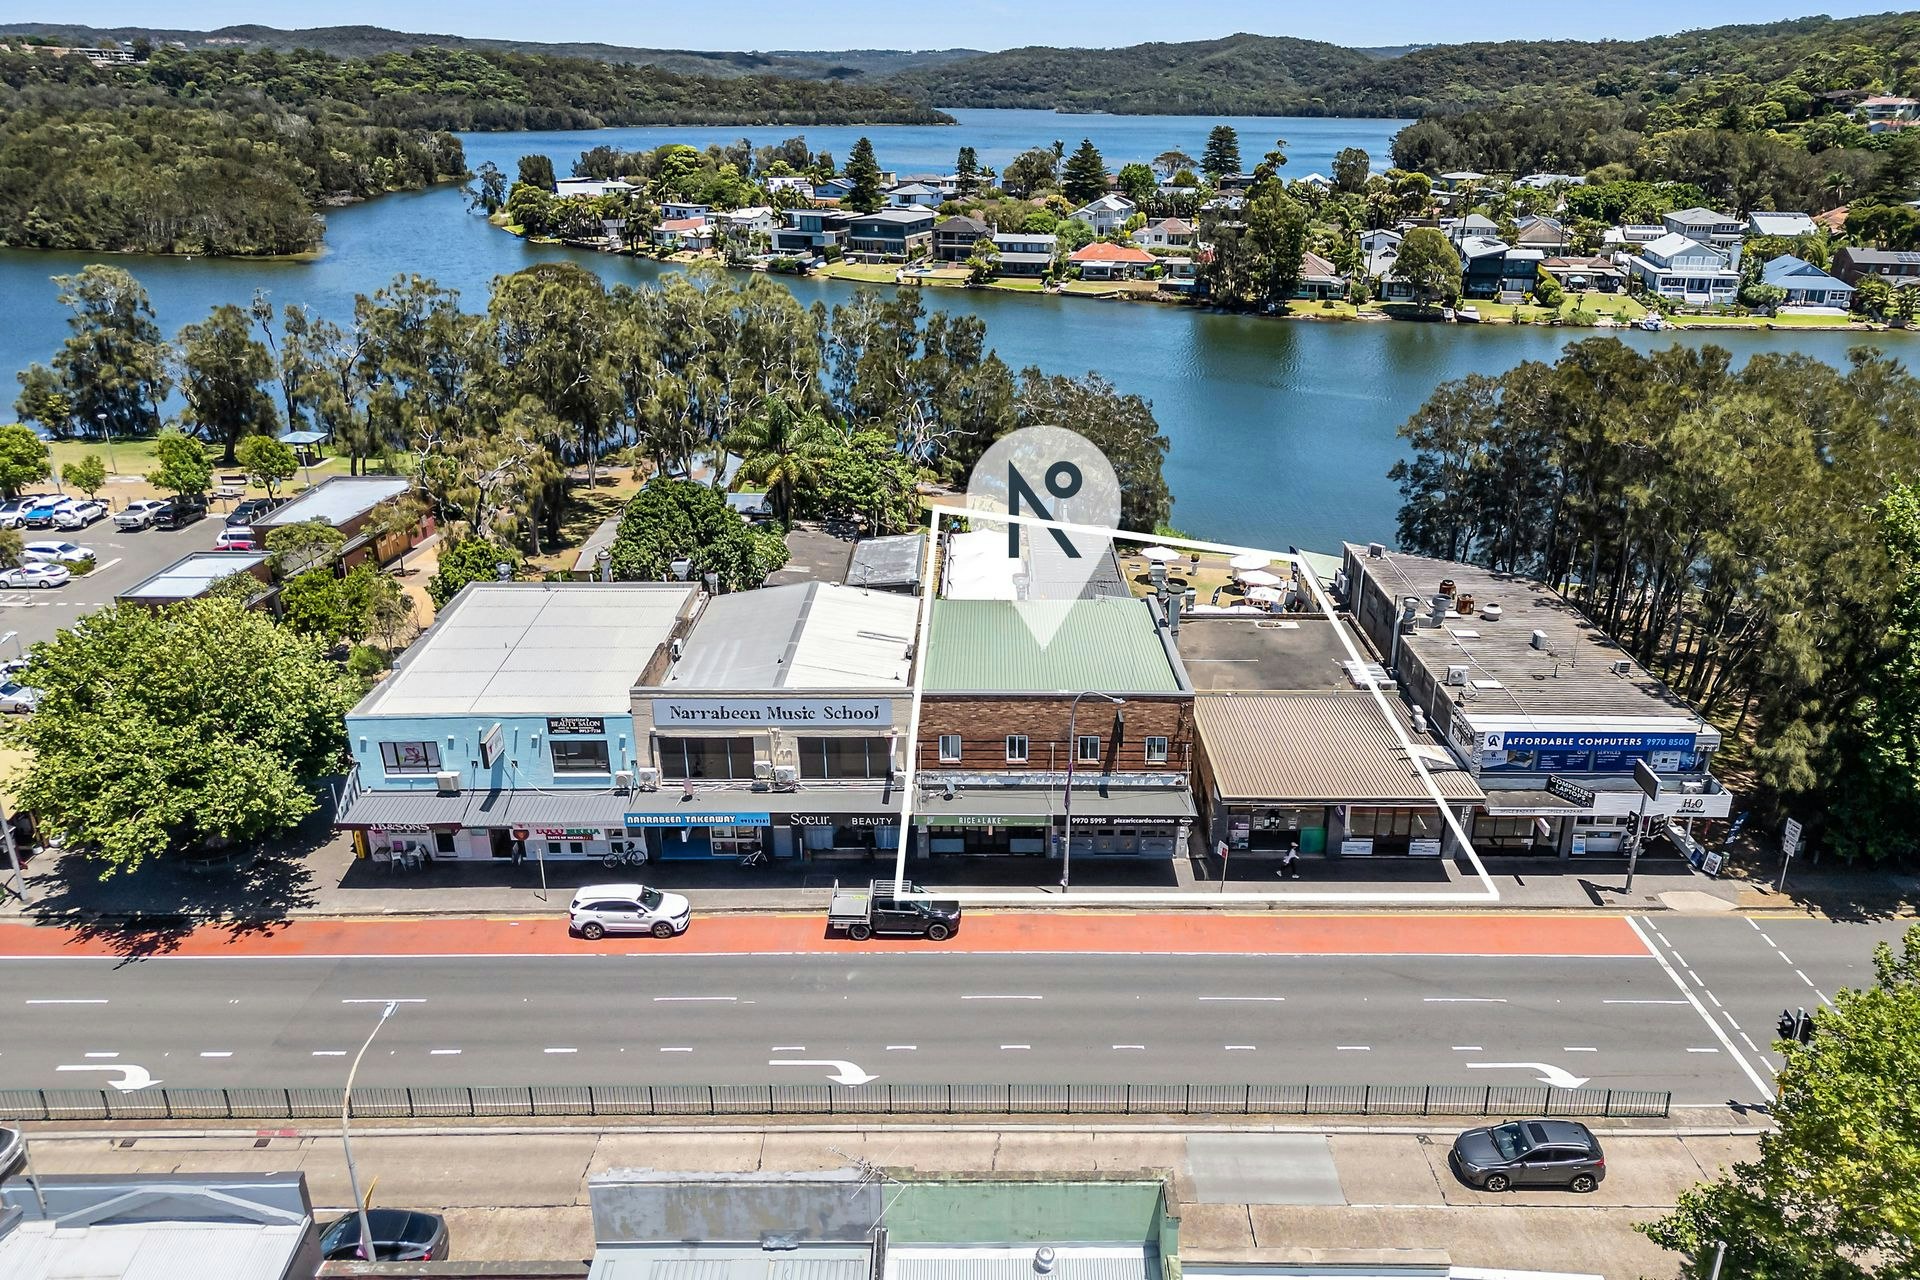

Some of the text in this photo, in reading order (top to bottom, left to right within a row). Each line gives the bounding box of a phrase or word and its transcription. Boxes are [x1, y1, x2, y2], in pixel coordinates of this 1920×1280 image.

[669, 705, 880, 720] Narrabeen Music School
[1506, 737, 1690, 746] AFFORDABLE COMPUTERS 9970 8500
[1550, 776, 1593, 798] COMPUTERS
[1555, 784, 1586, 801] LAPTOPS
[627, 816, 682, 824] NARRABEEN
[685, 815, 736, 823] TAKEAWAY
[851, 817, 893, 826] BEAUTY
[959, 817, 976, 825] RICE
[982, 817, 1002, 825] LAKE
